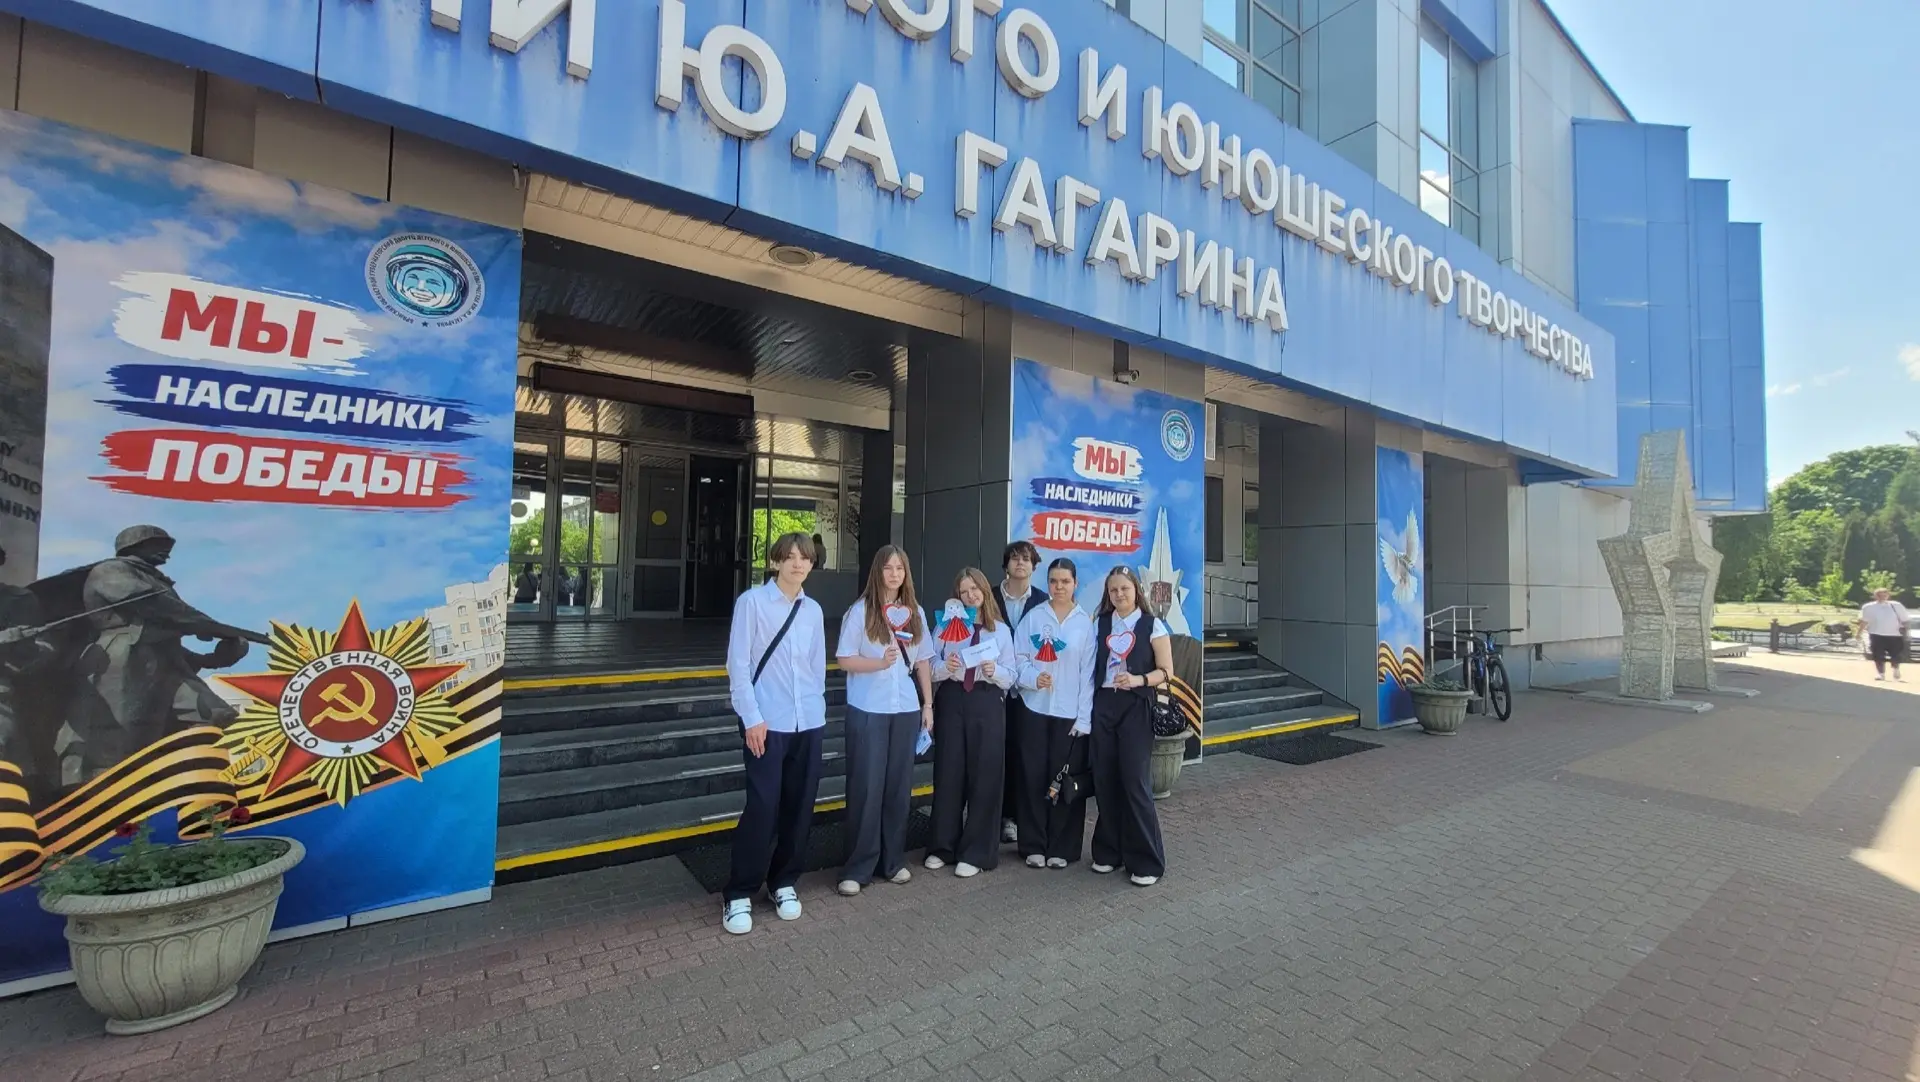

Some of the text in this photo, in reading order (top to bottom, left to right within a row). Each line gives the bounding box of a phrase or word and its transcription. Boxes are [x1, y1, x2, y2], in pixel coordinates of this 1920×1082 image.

[955, 130, 1289, 333] ГАГАРИНА
[1078, 47, 1127, 141] И
[1142, 85, 1454, 306] ЮНОШЕСКОГО
[1456, 270, 1594, 381] ТВОРЧЕСТВА
[155, 376, 446, 432] НАСЛЕДНИКИ
[146, 438, 438, 498] ПОБЕДЫ!
[1045, 483, 1133, 508] НАСЛЕДНИКИ
[1045, 517, 1133, 547] ПОБЕДЫ!
[282, 652, 412, 749] ОТЕЧЕСТВЕННАЯ ВОЙНА
